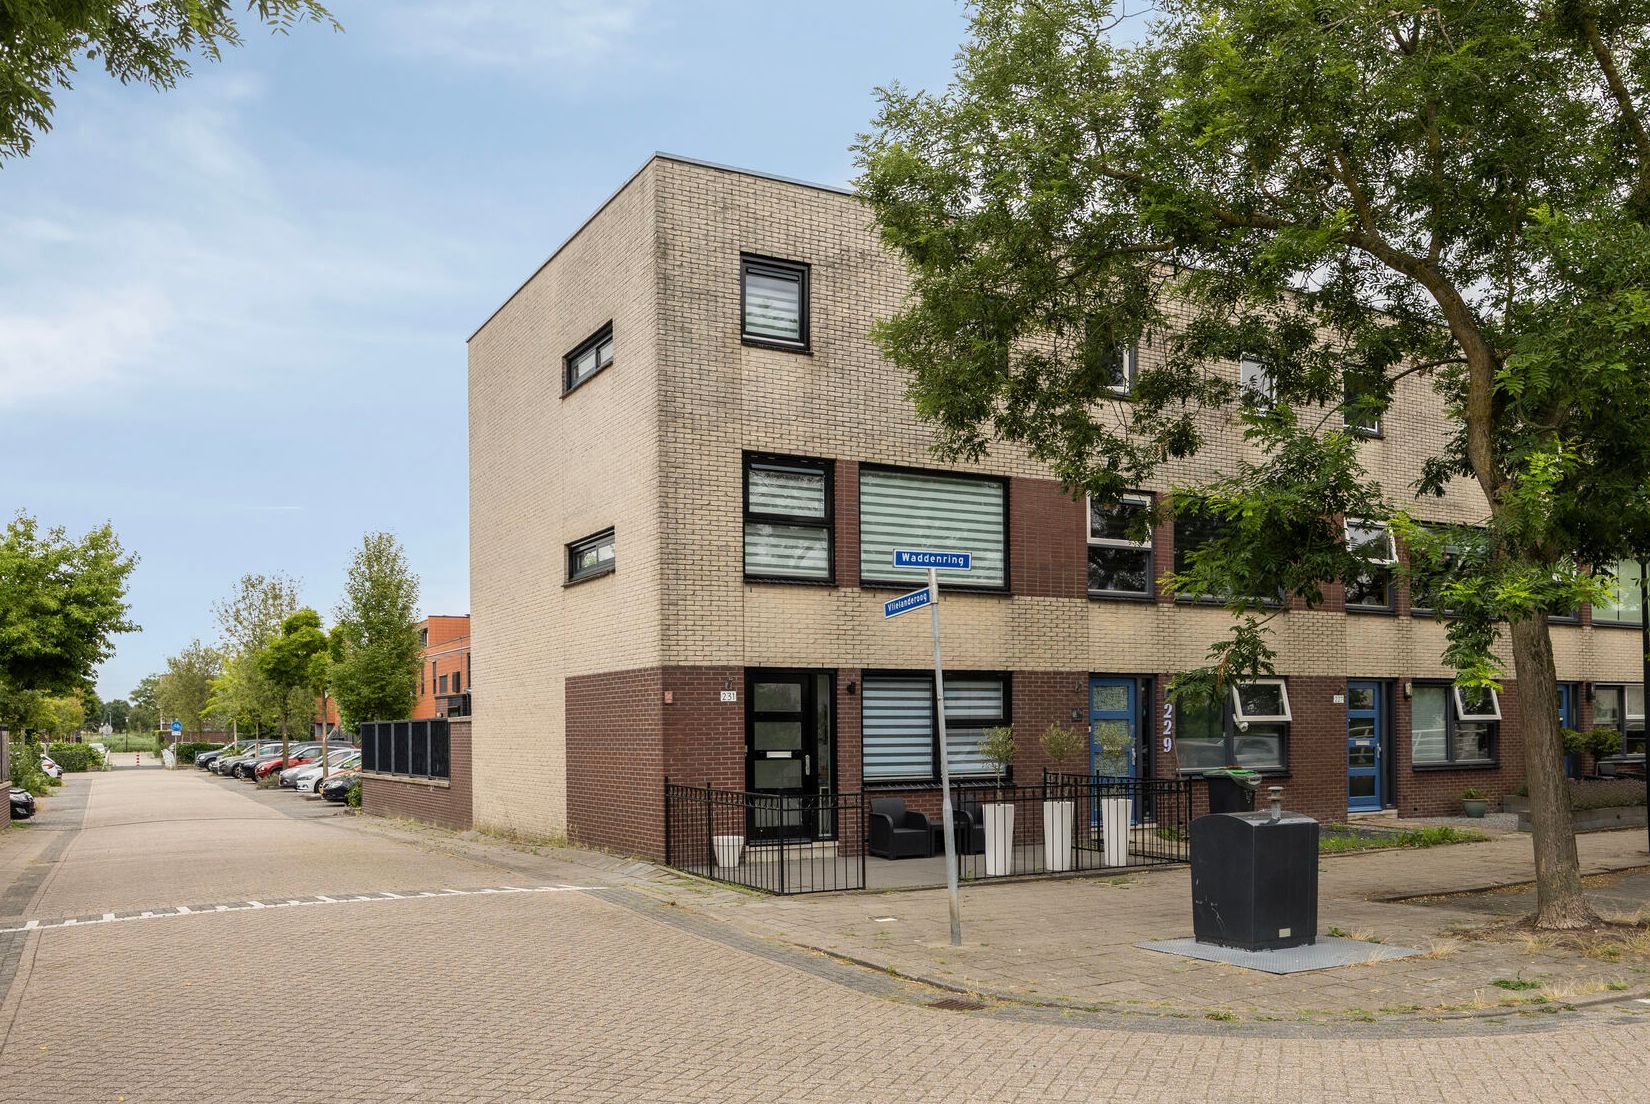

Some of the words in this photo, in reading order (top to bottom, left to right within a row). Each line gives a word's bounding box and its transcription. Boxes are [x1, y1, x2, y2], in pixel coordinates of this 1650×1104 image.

[902, 552, 964, 567] Waddenring
[887, 593, 927, 612] Vlielanderoog
[721, 692, 735, 701] 231
[1163, 703, 1173, 753] 229
